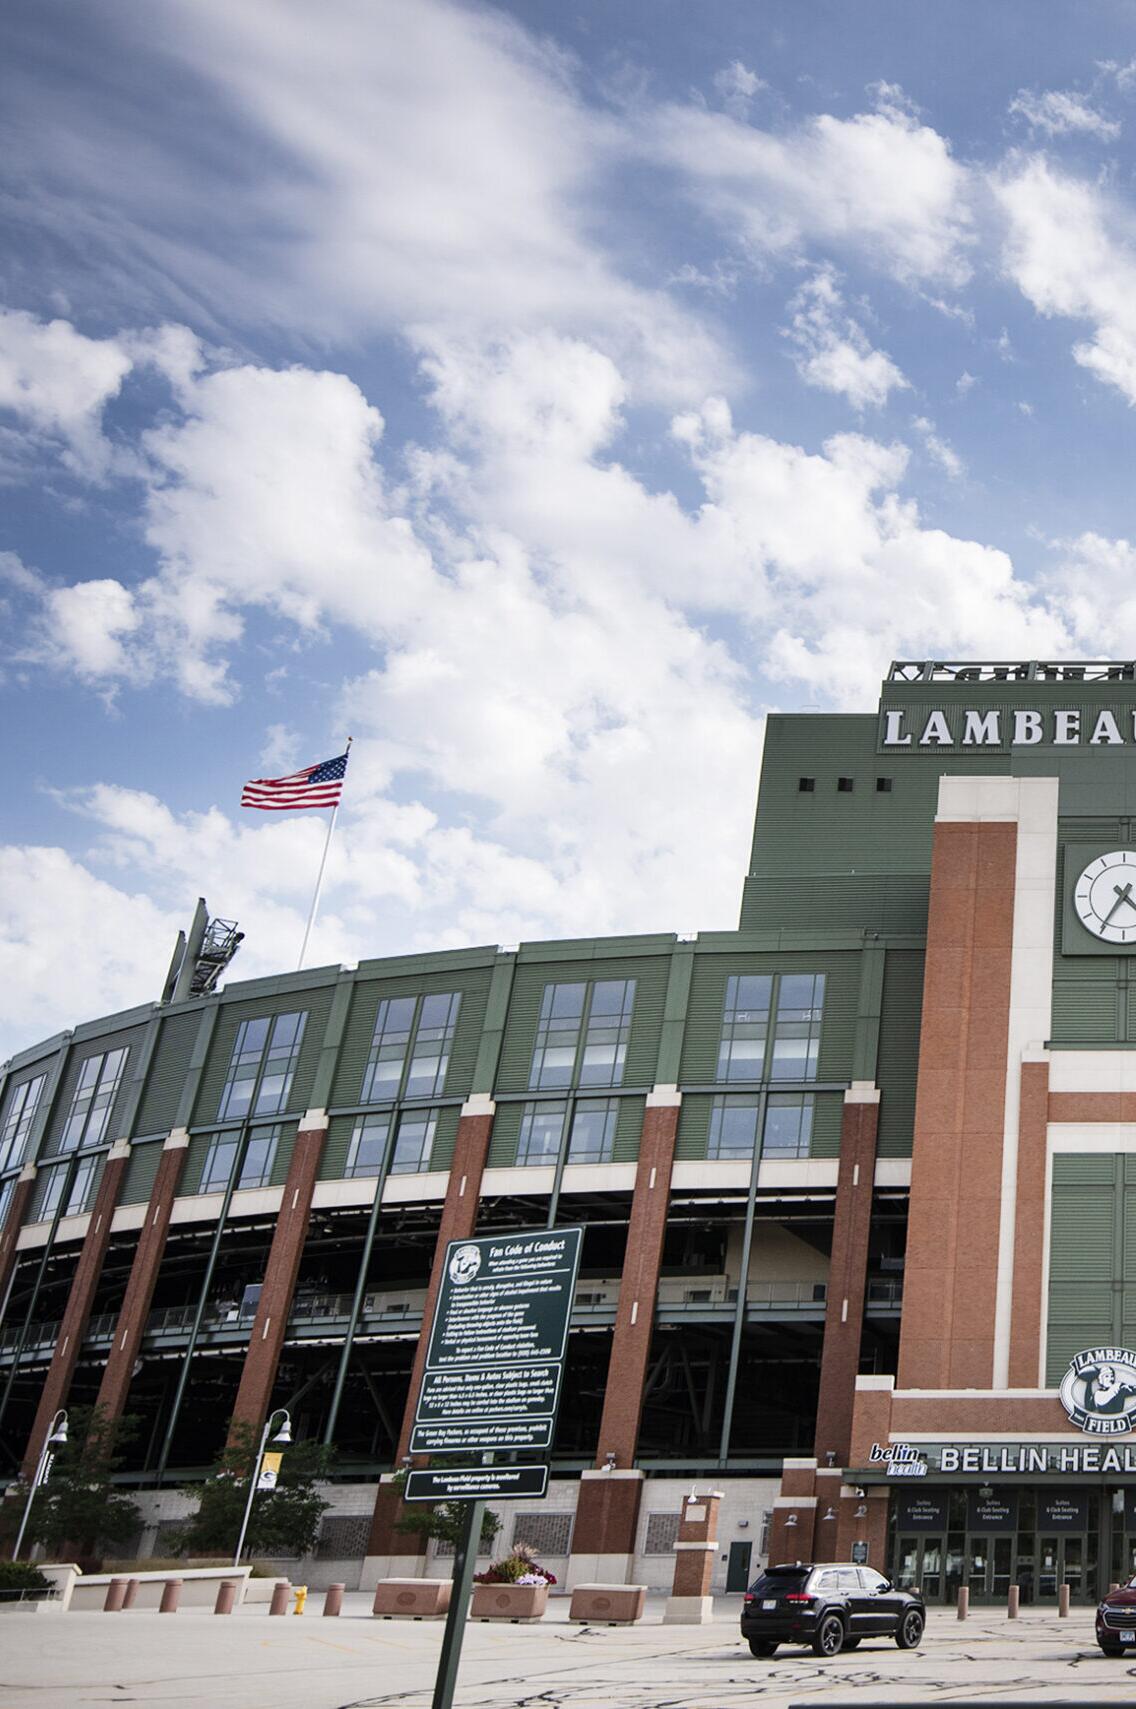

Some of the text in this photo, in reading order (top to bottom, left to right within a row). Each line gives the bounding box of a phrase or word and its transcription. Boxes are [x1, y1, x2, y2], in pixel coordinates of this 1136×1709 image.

[505, 1244, 523, 1256] Code
[524, 1242, 534, 1254] of
[534, 1240, 565, 1252] Conduct
[1087, 1419, 1126, 1433] FIELD
[870, 1445, 918, 1461] bellin
[941, 1448, 1047, 1472] BELLIN
[888, 1462, 926, 1475] health
